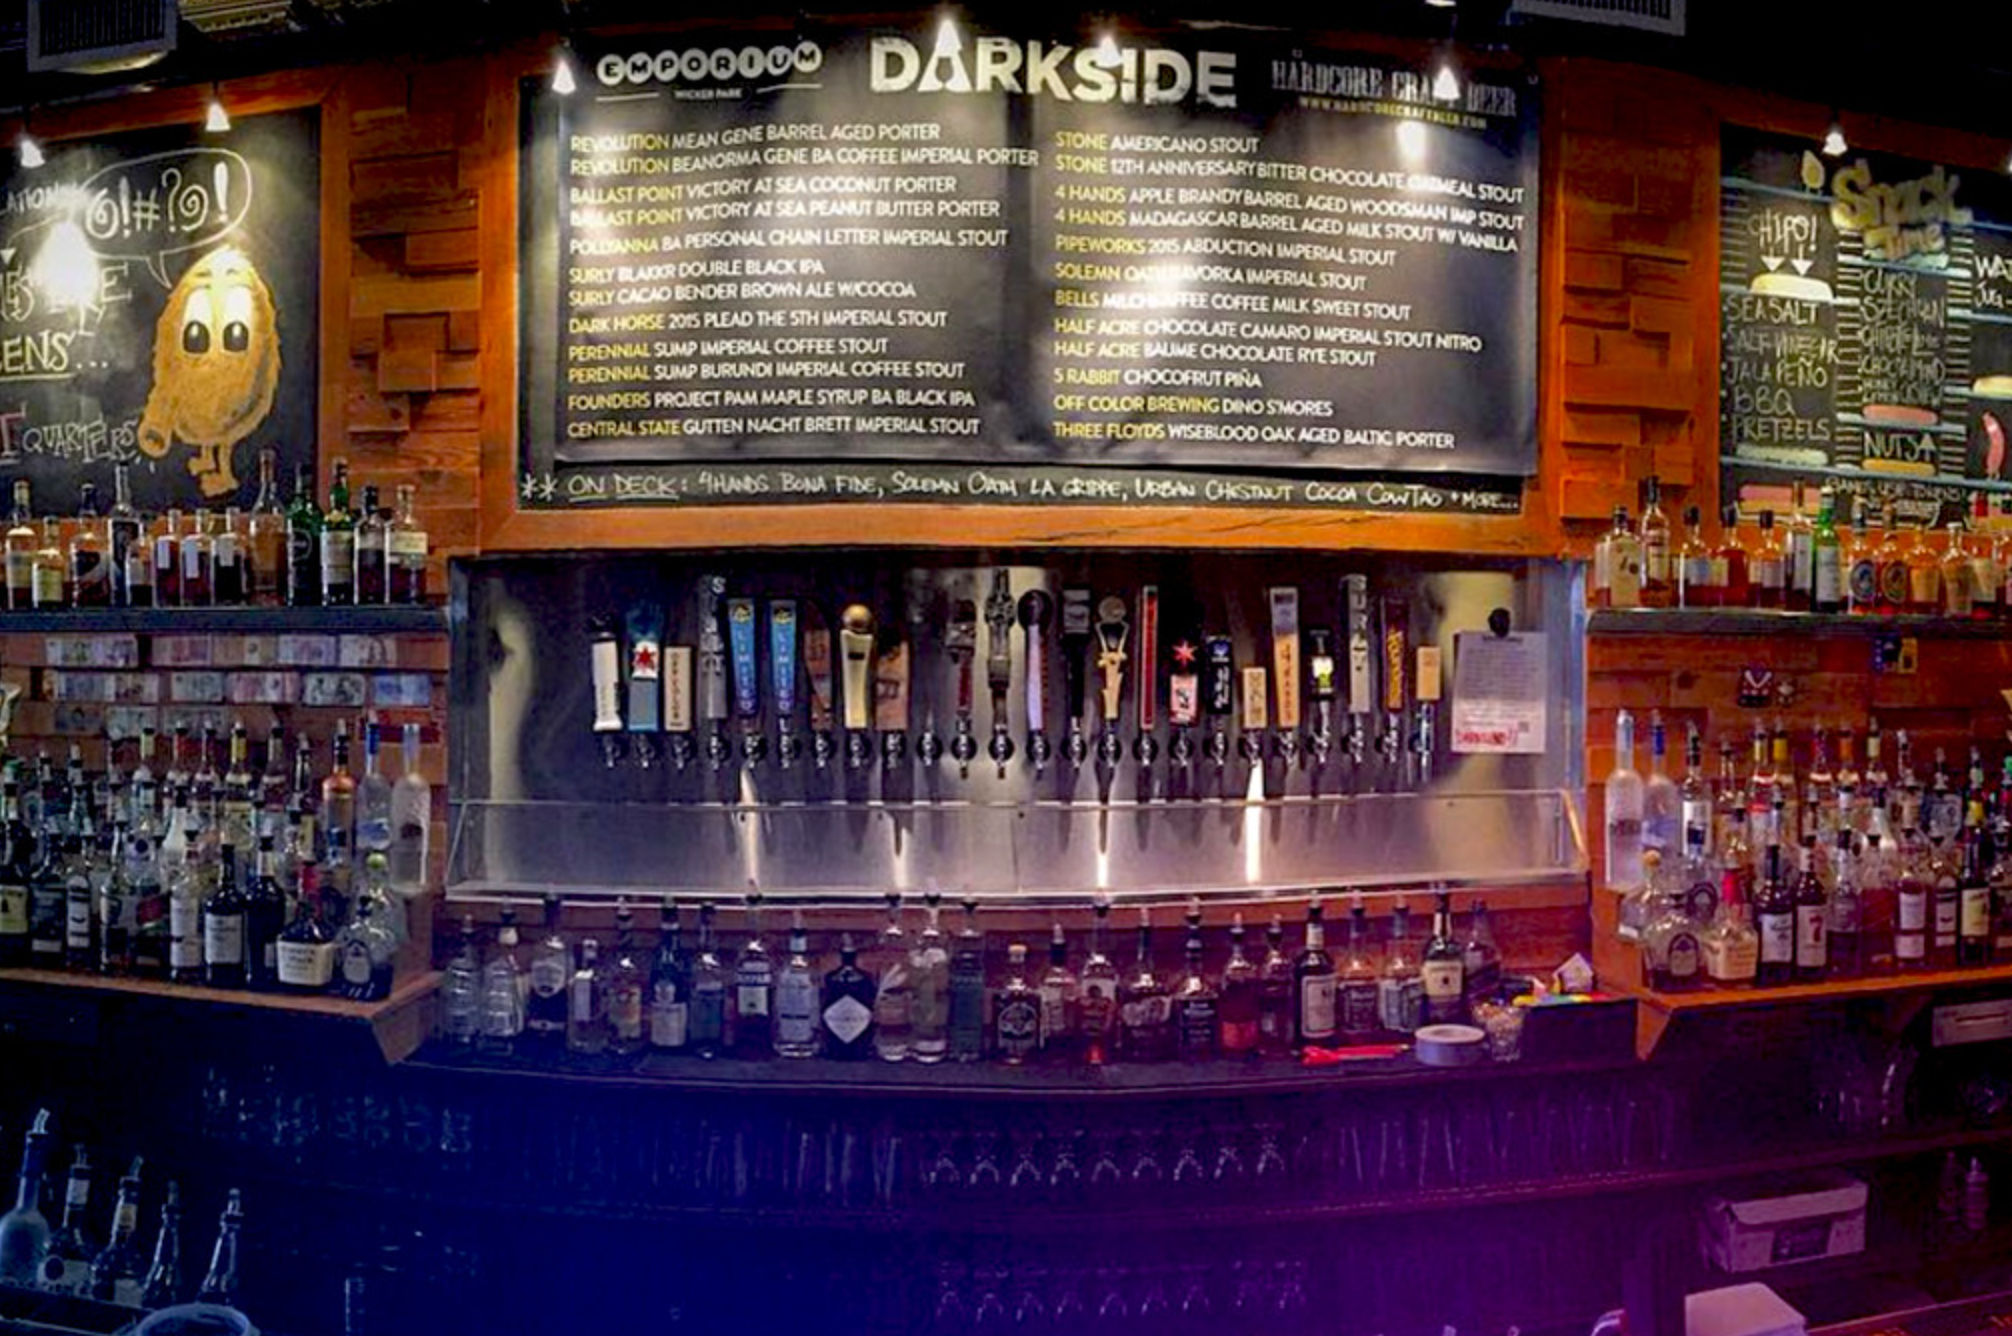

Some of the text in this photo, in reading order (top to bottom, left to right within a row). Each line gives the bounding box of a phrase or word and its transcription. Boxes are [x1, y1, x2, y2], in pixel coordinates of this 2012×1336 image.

[596, 41, 822, 86] EMPORIUM
[870, 36, 1237, 108] DARKSIDE
[675, 87, 742, 99] WICKER PARK
[1271, 59, 1517, 118] HARDCORE CRA BEER
[571, 123, 941, 152] REVOLUTION MEAN GENE BARREL AGED PORTER
[1055, 131, 1260, 154] STONE AMERICANO STOUT
[571, 147, 1039, 176] REVOLUTION BEANORMA GENE BA COFFEE IMPERIAL PORTER
[570, 176, 957, 204] BALLAST POINT VICTORY AT SEA COCONUT PORTER
[1054, 184, 1525, 231] 4 HANDS APPLE BRANDY BARREL AGED WOODSMAN IMP STOUT
[1054, 208, 1519, 253] 4 HANDS MADAGASCAR BARREL AGED MILK STOUT W/ VANILLA
[1055, 233, 1397, 268] PIPEWORKS 2015 ABDUCTION IMPERIAL STOUT
[569, 288, 616, 308] SURLY
[617, 285, 672, 304] CACAO
[675, 282, 738, 301] BENDER
[740, 281, 802, 300] BROWN
[804, 280, 835, 297] ALE
[569, 310, 948, 334] DARK HORSE 2015 PLEAD THE 5TH IMPERIAL STOUT
[1054, 317, 1482, 353] HALF ACRE CHOCOLATE CAMARO IMPERIAL STOUT NITRO
[568, 337, 889, 362] PERENNIAL SUMP IMPERIAL COFFEE STOUT
[1054, 340, 1377, 368] HALF ACRE BAUME CHOCOLATE RYE STOUT
[1054, 366, 1263, 389] 5 RABBIT CHOCOFRUT PIÑA
[567, 388, 976, 412] FOUNDERS PROJECT PAM MAPLE SYRUP BA BLACK IPA
[1053, 394, 1334, 418] OFF COLOR BREWING DINO S'MORES
[567, 415, 981, 439] CENTRAL STATE GUTTEN NACHT BRETT IMPERIAL STOUT
[1053, 421, 1455, 449] THREE FLOYDS WISEBLOOD OAK AGED BALTIC PORTER
[1731, 412, 1832, 444] PRETZELS
[567, 474, 606, 496] ON
[1029, 478, 1056, 496] LA
